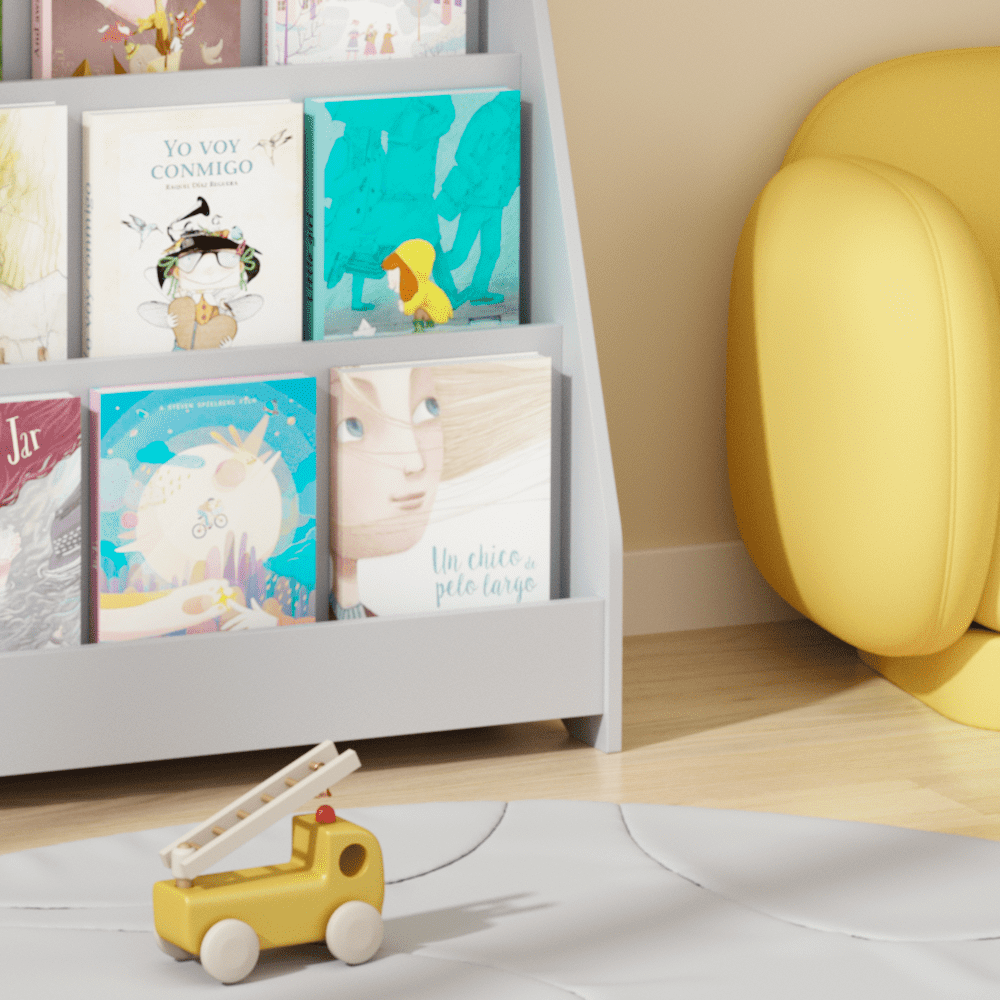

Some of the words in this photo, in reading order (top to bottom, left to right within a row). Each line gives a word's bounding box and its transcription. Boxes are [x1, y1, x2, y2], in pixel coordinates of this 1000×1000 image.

[150, 159, 253, 180] CONMIGO
[5, 415, 42, 466] Jar
[432, 545, 462, 575] Un
[467, 543, 522, 570] chico
[432, 573, 478, 608] pelo
[483, 573, 538, 604] largo
